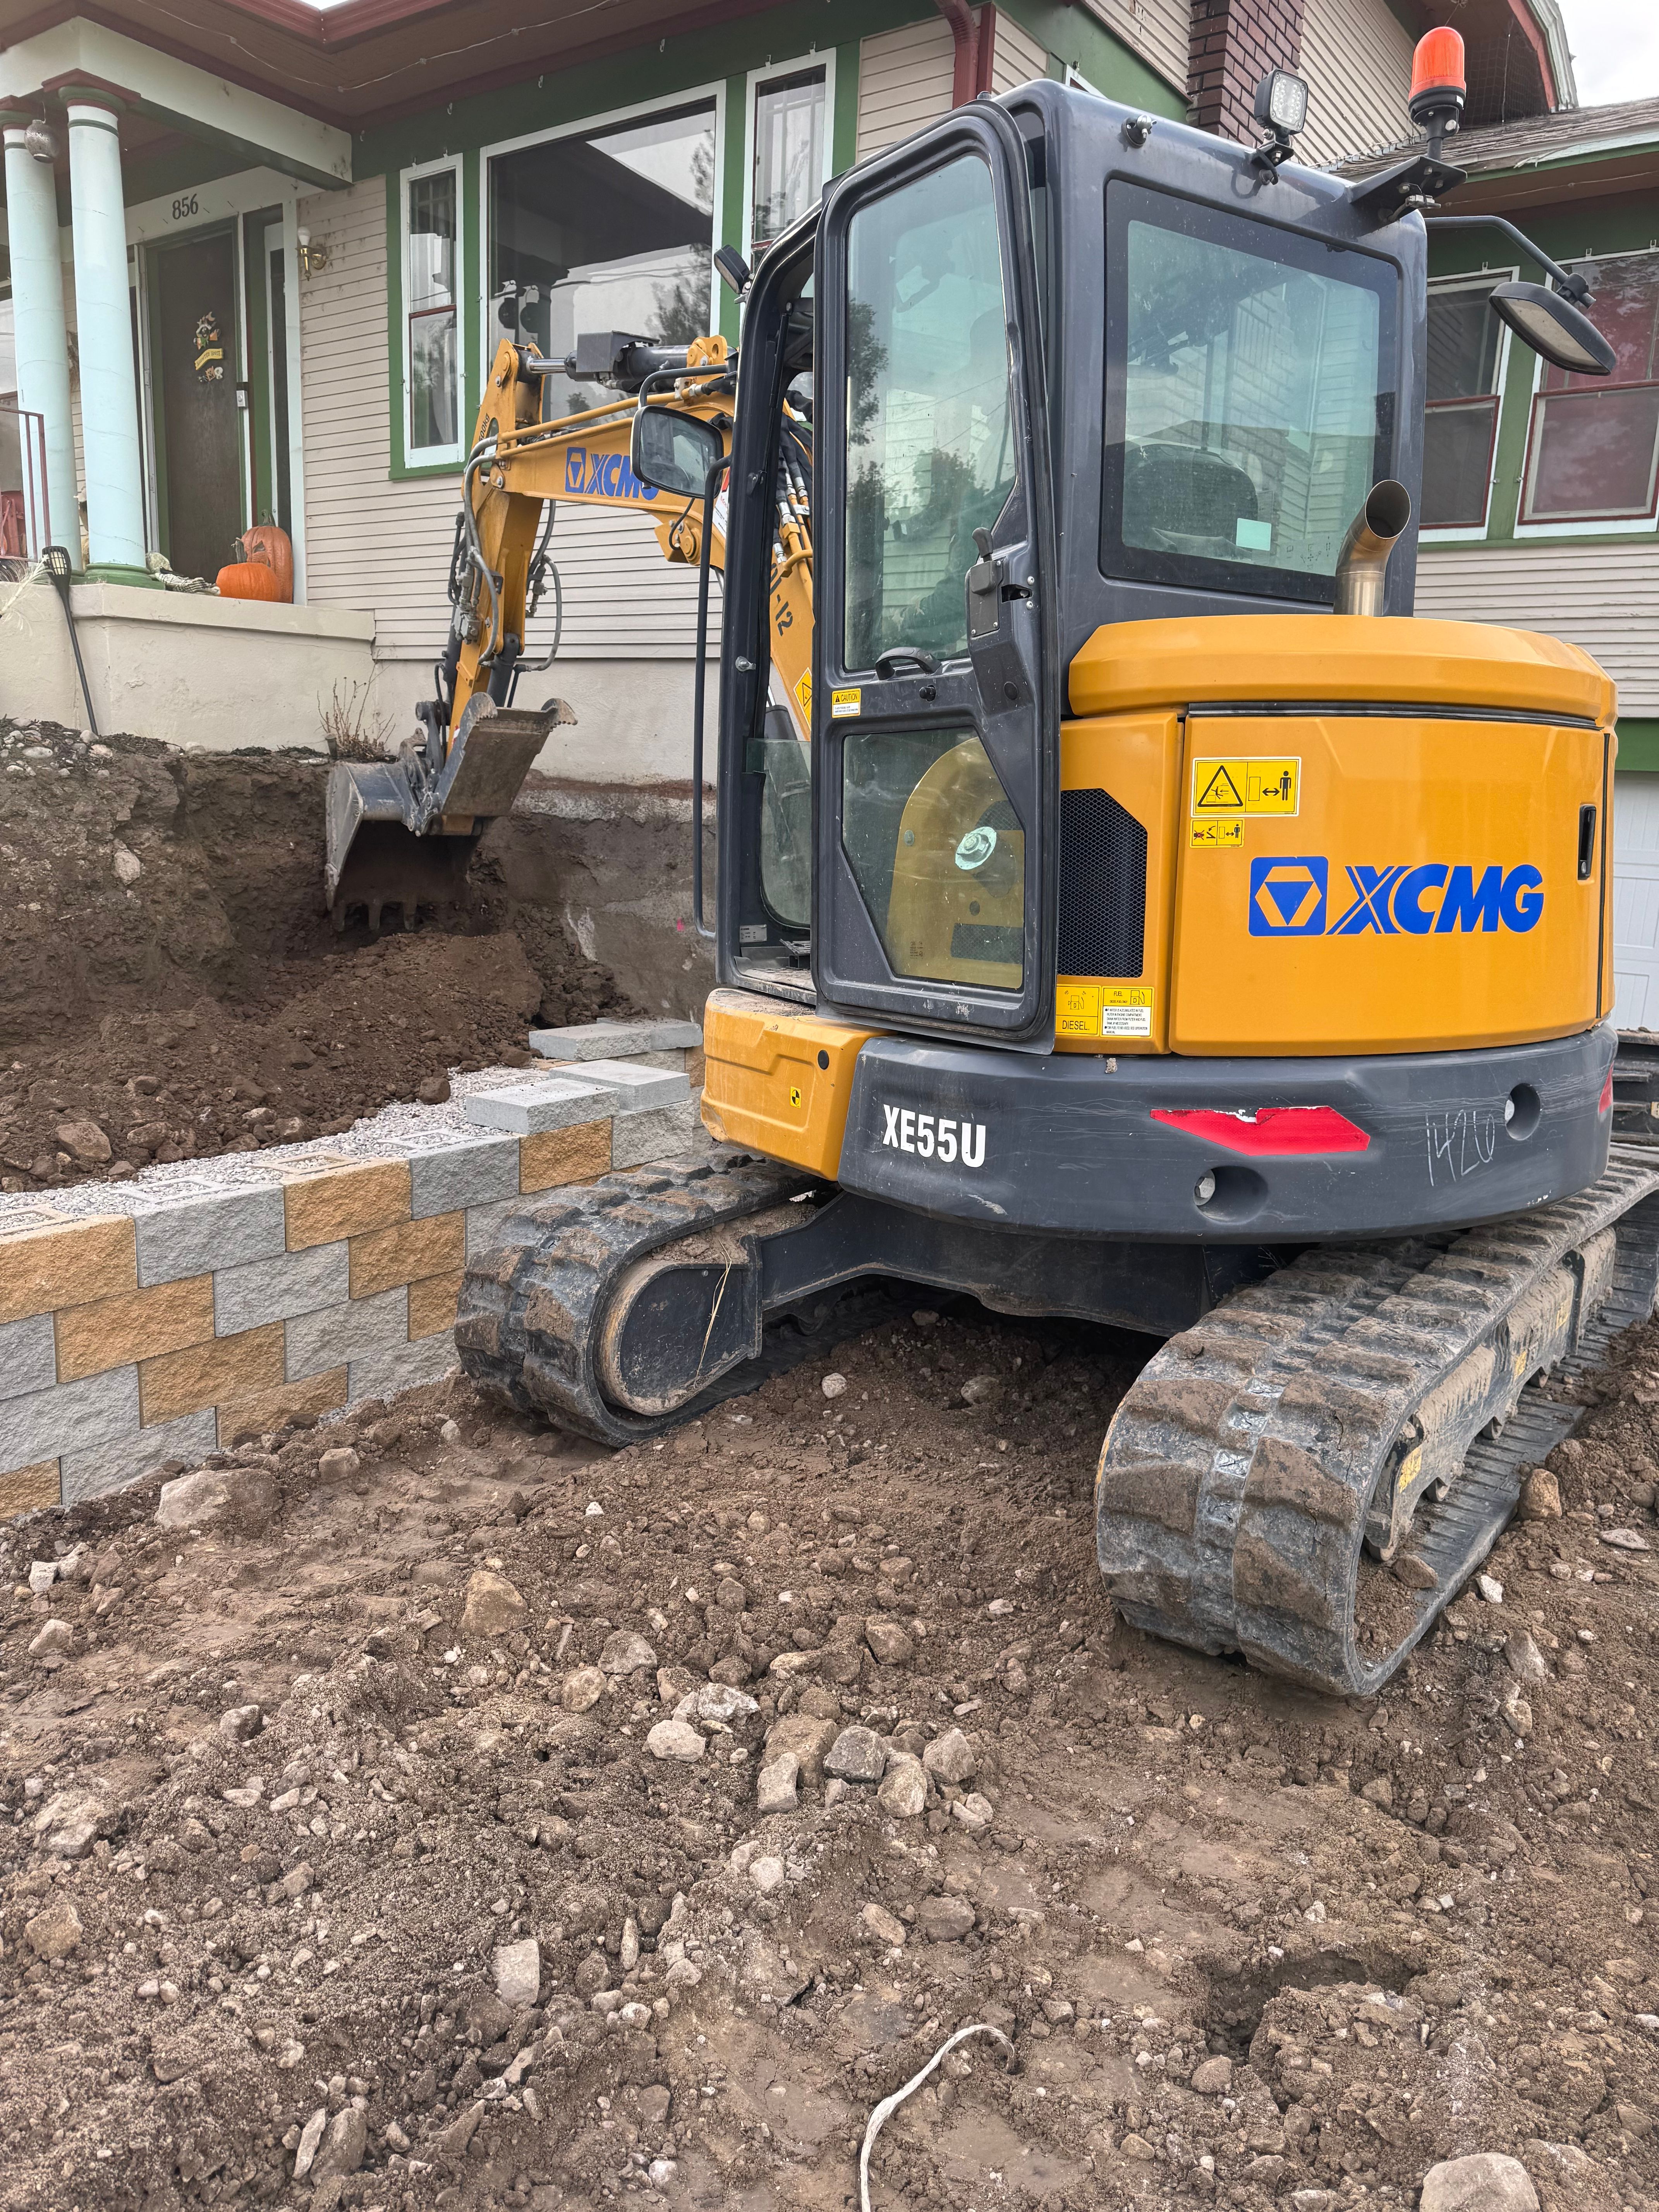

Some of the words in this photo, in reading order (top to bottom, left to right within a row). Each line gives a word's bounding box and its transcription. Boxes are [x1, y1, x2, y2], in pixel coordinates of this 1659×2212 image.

[172, 194, 198, 220] 856
[841, 693, 857, 702] CAUTION
[1326, 864, 1544, 935] XCMG
[883, 1104, 986, 1168] XE55U
